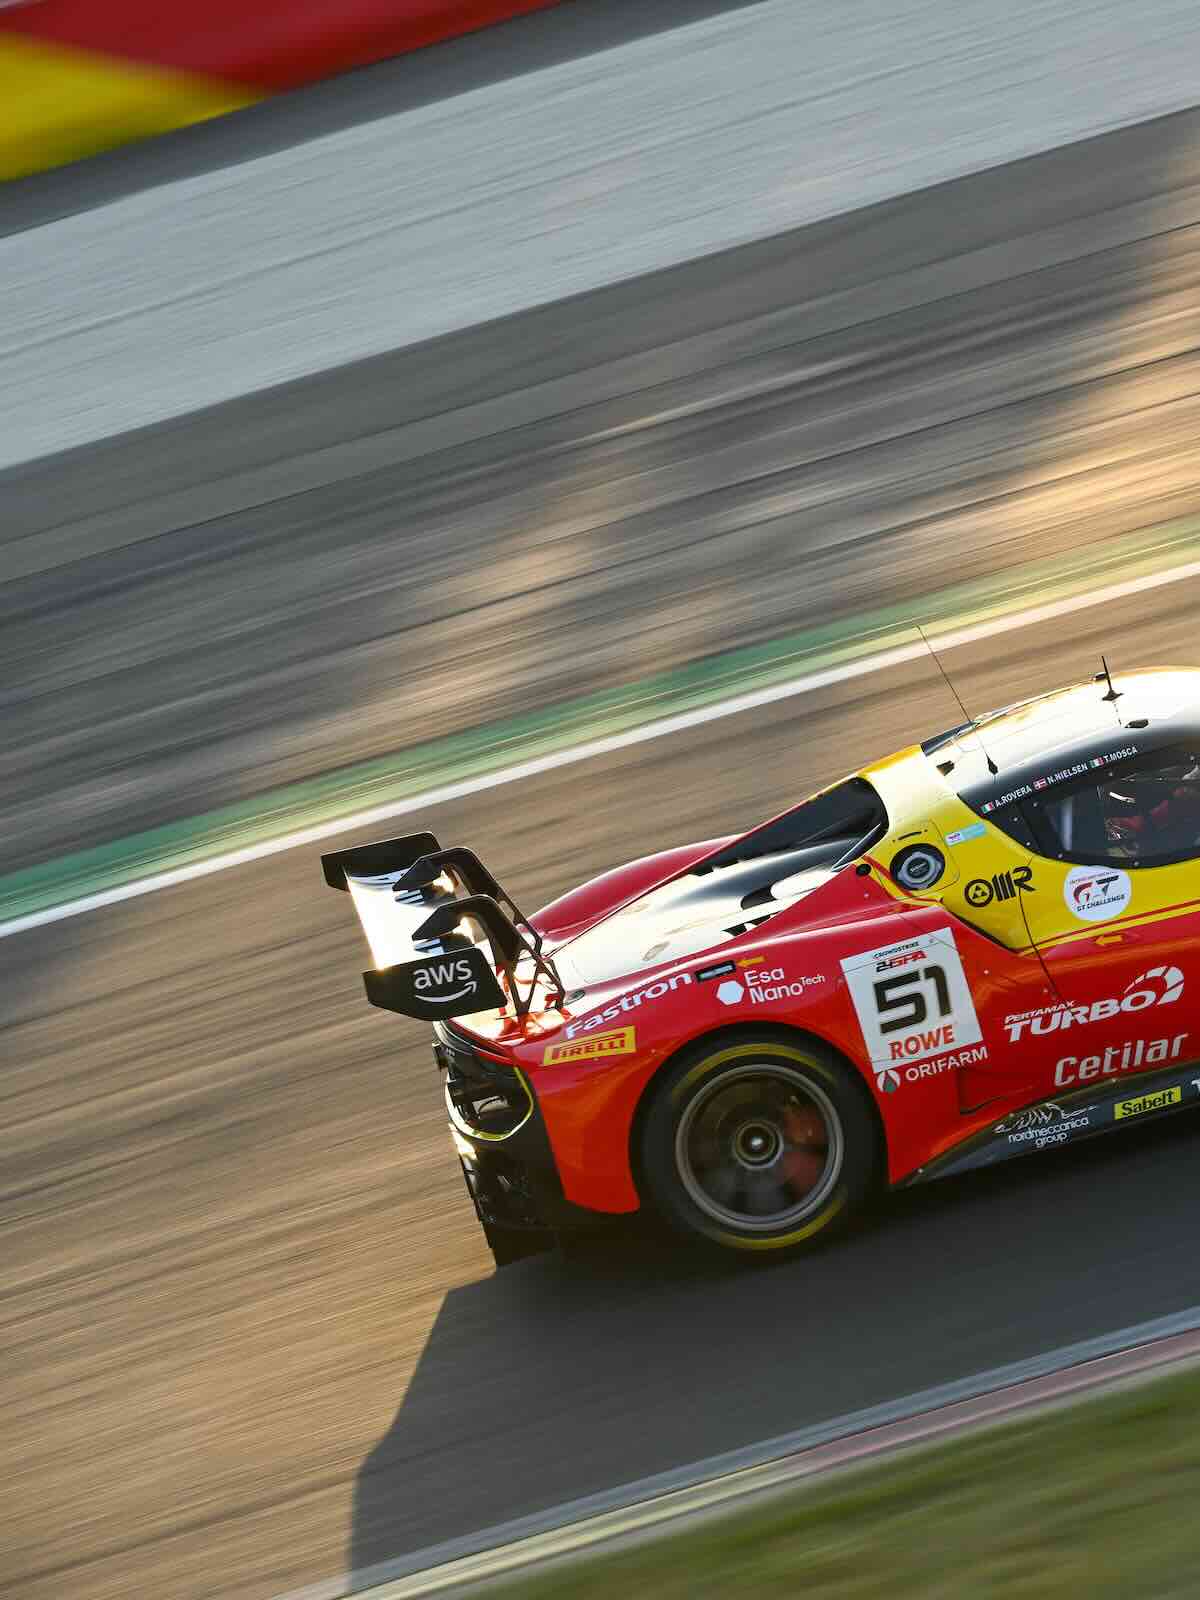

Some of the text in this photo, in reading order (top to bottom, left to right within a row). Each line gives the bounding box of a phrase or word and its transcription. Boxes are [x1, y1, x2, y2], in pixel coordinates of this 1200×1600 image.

[995, 746, 1138, 808] A.ROVERA N.NIELSEN T.MOSCA
[1087, 894, 1125, 909] CHALLENGE
[413, 959, 473, 990] aws
[744, 967, 785, 986] Esa
[750, 973, 825, 1004] Nano Tech
[566, 972, 693, 1039] Fastron
[873, 965, 952, 1034] 51
[1005, 1000, 1076, 1024] PERTAMAX
[1004, 990, 1157, 1042] TURBO
[551, 1032, 625, 1060] PIRELLI
[889, 1025, 955, 1060] ROWE
[905, 1046, 988, 1081] ORIFARM
[1054, 1033, 1189, 1087] Cetilar
[1121, 1090, 1175, 1117] Sabelt
[1008, 1117, 1089, 1144] nordmeccanica
[1035, 1132, 1068, 1149] group
